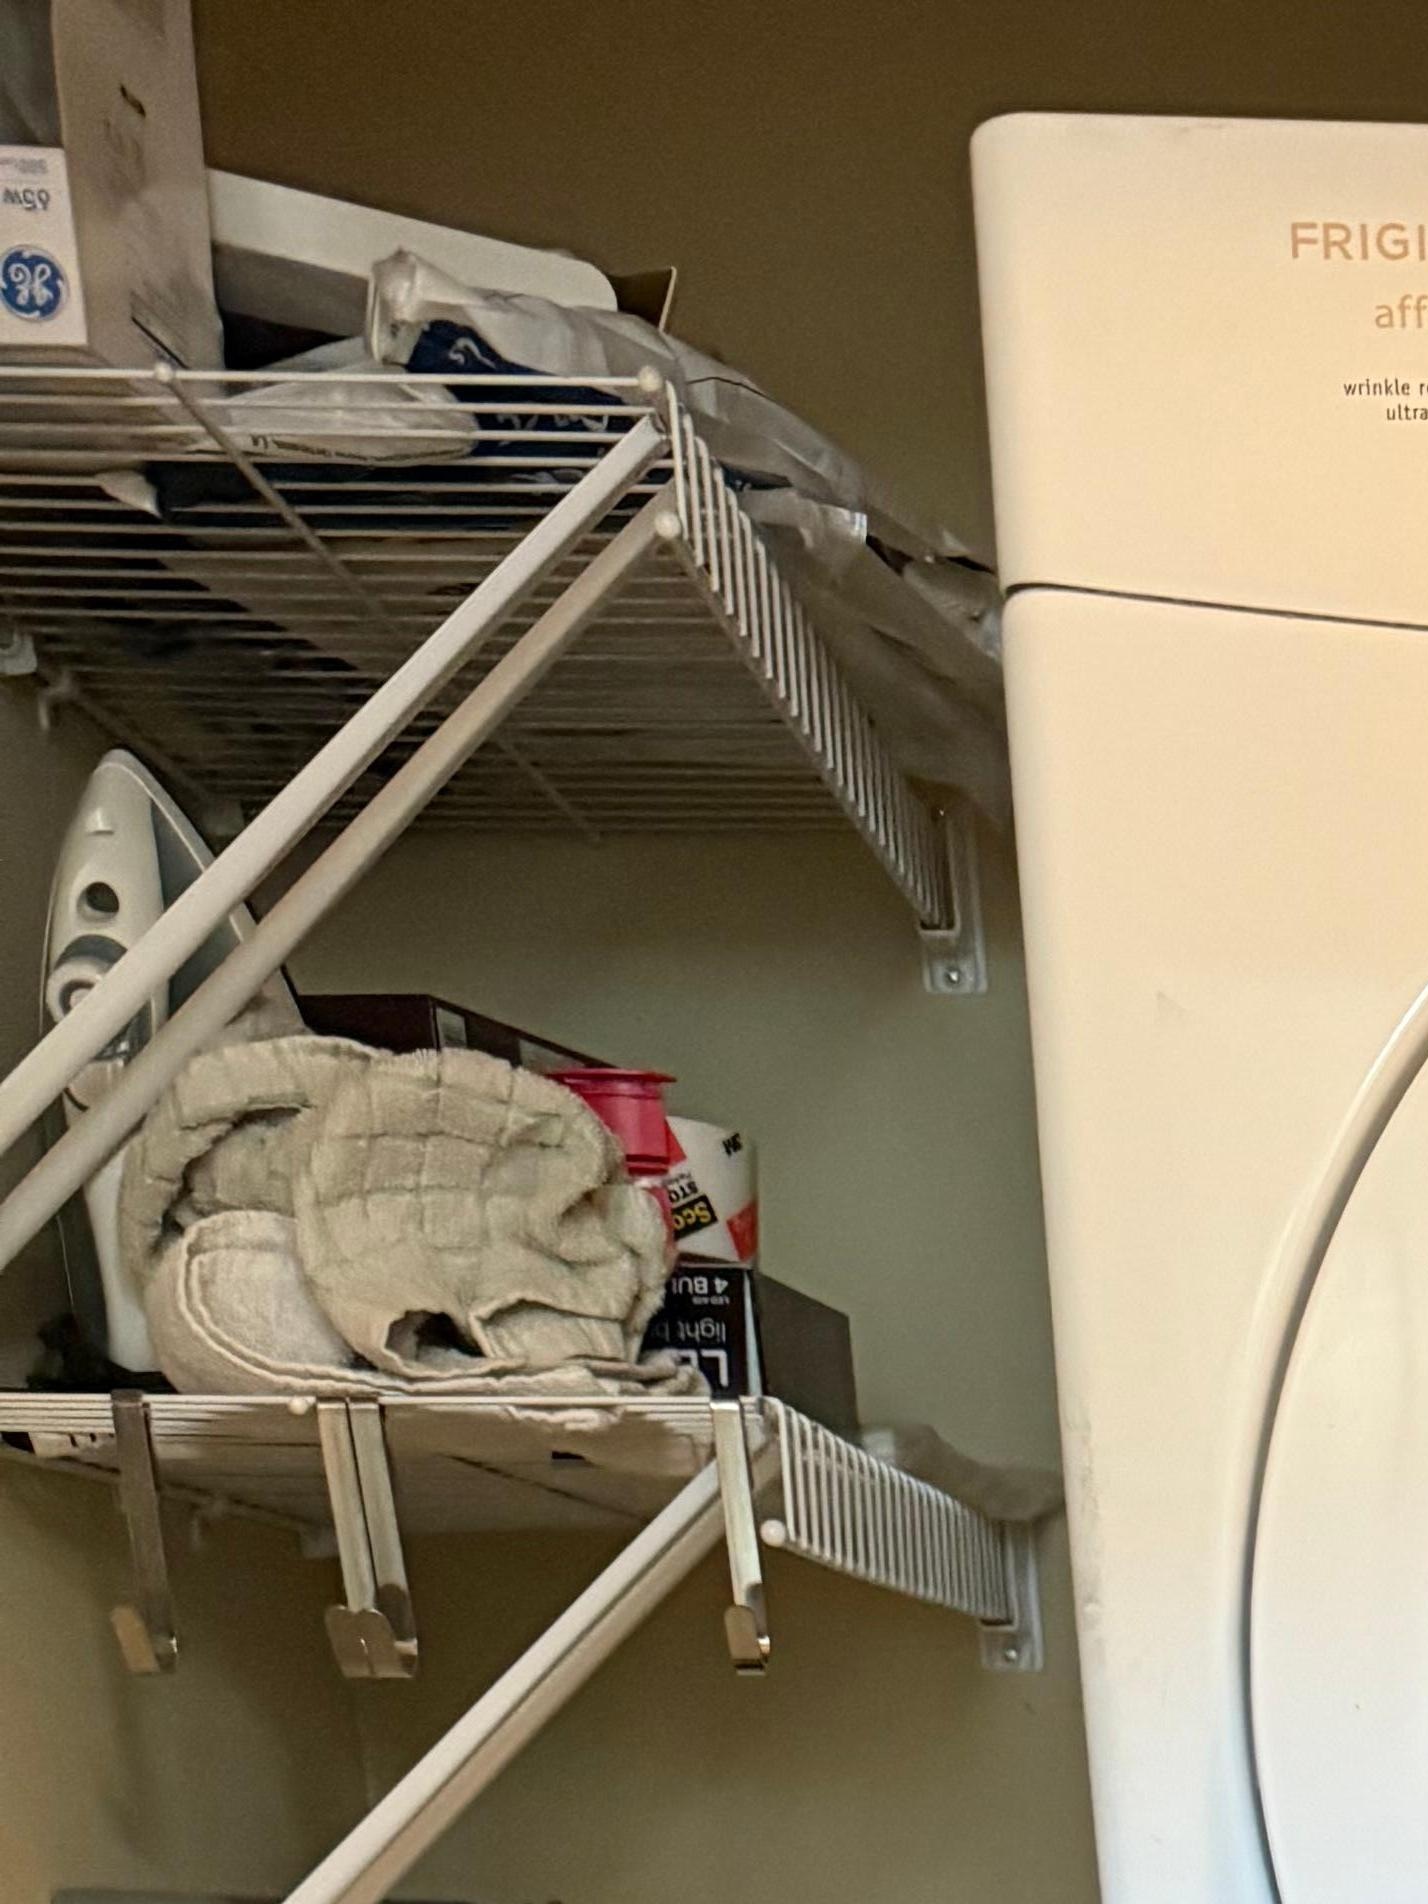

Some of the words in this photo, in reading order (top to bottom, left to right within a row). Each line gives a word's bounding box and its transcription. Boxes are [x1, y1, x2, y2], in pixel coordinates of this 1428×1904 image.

[1343, 378, 1411, 397] wrinkle
[1386, 404, 1428, 422] ultra
[714, 1276, 729, 1294] 4
[678, 1317, 726, 1346] light
